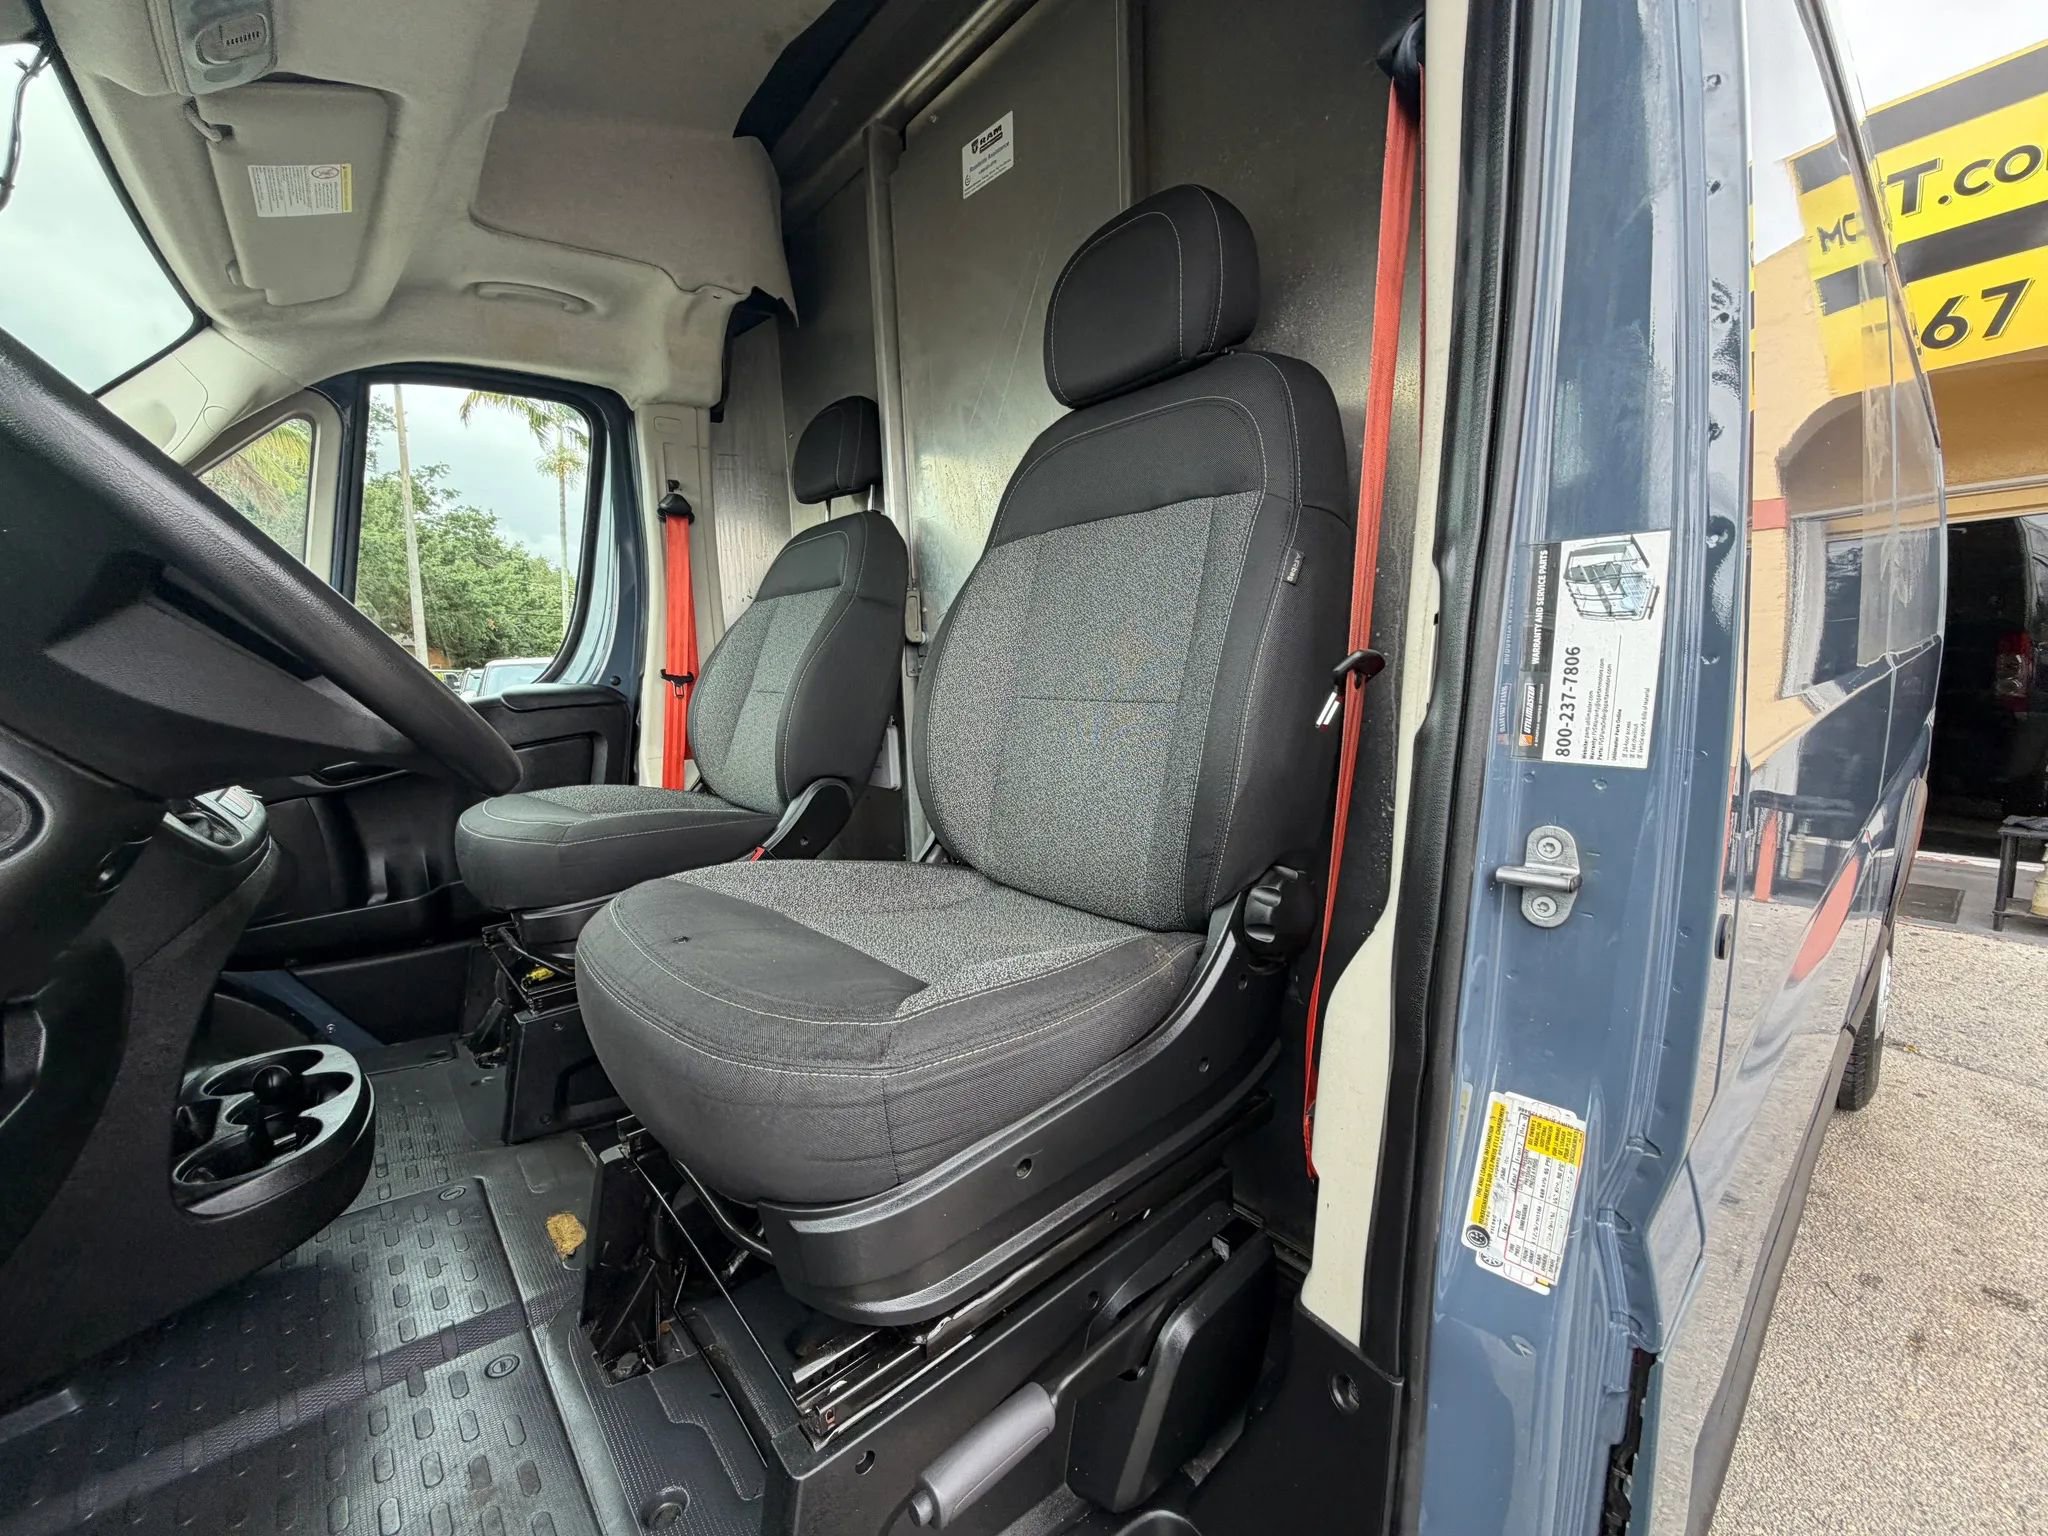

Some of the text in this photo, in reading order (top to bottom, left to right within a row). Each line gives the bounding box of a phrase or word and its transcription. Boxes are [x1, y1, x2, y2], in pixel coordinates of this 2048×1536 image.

[980, 124, 1002, 145] RAM
[1887, 143, 2048, 218] T.CO
[1531, 549, 1548, 664] WARRANTY AND SERVICE PARTS
[1523, 685, 1535, 733] UTILIMASTER
[1554, 646, 1580, 757] 800-237-7806
